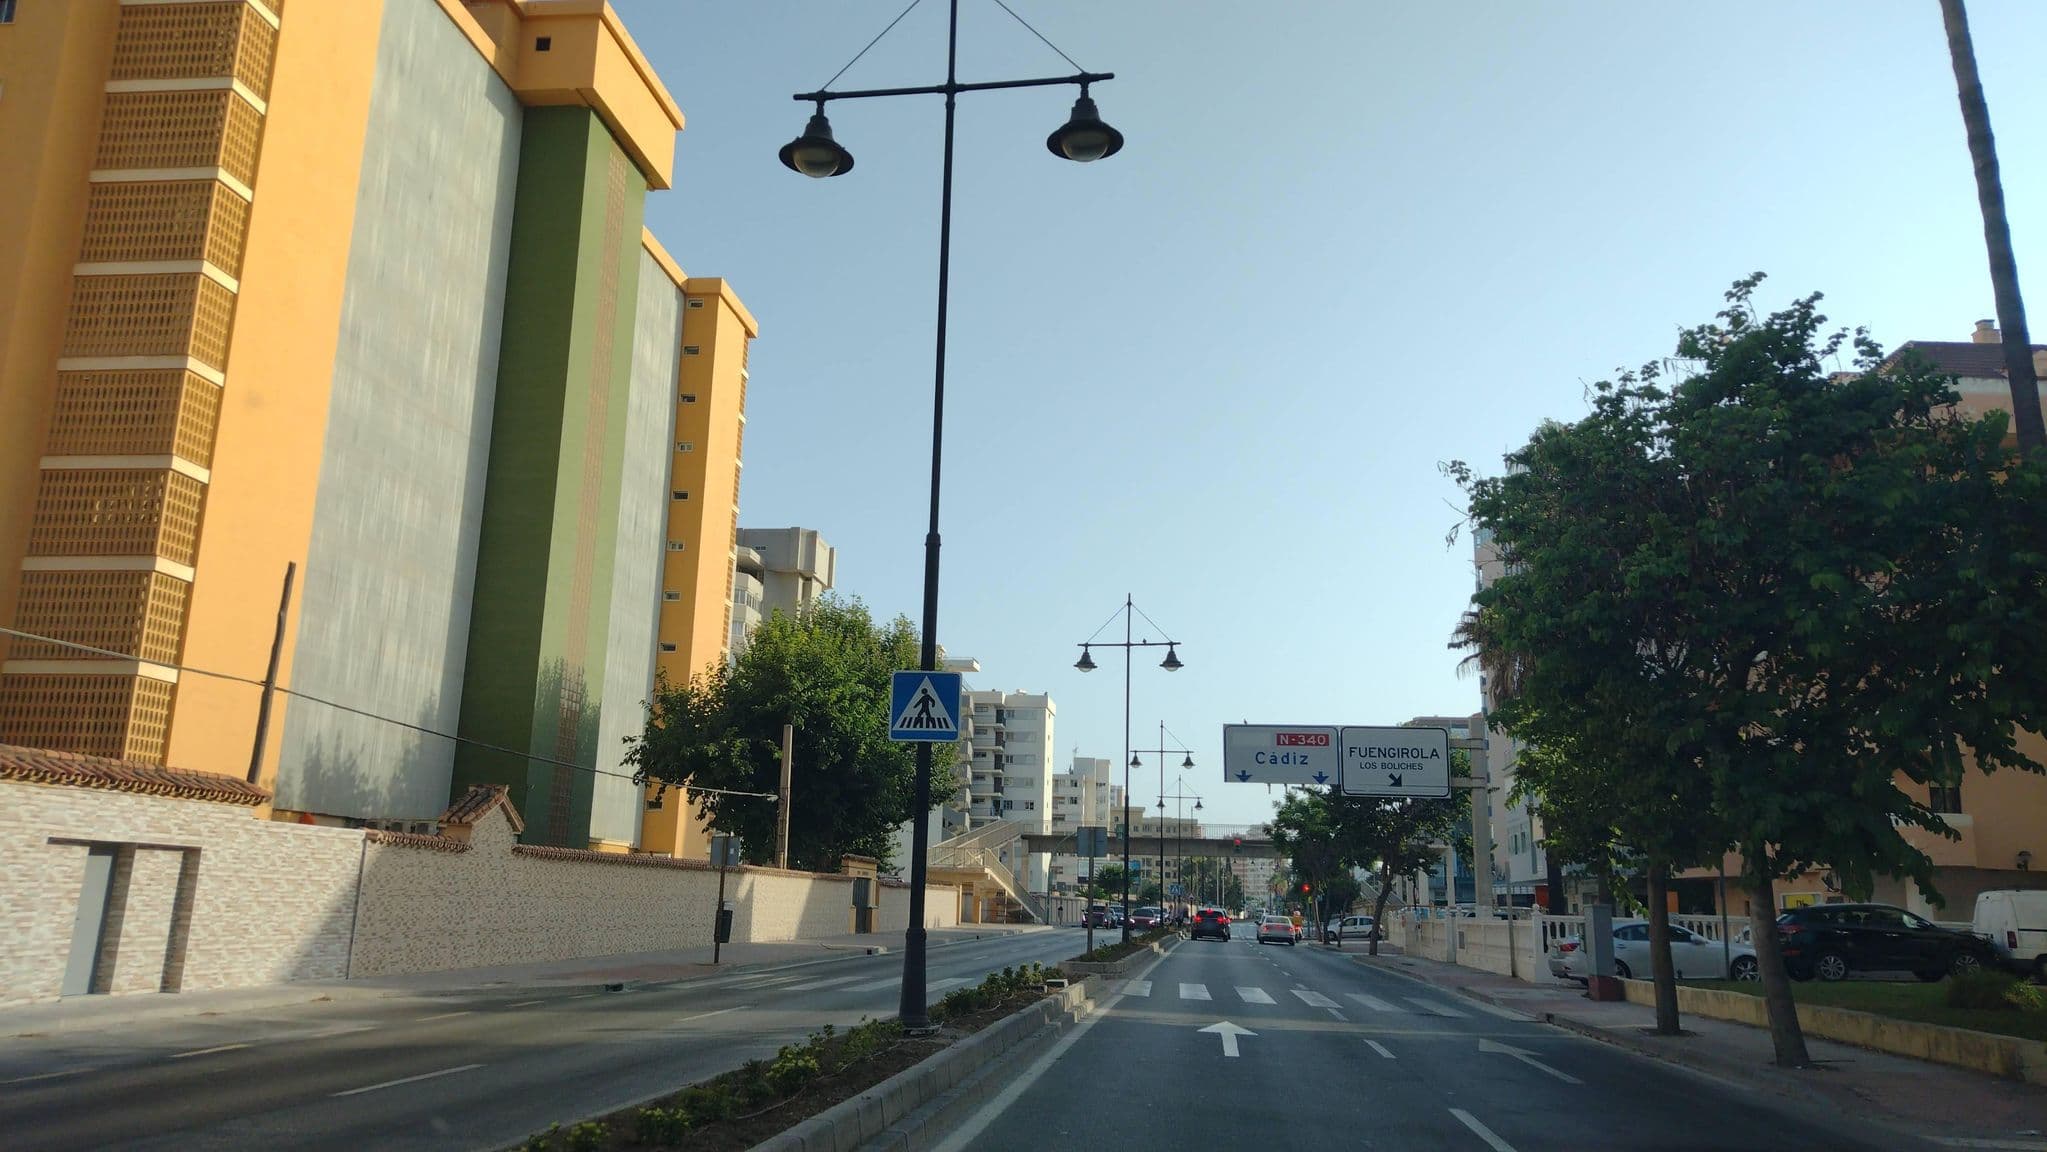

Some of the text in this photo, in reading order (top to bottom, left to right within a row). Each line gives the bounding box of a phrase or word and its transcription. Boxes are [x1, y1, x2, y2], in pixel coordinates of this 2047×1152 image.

[1280, 734, 1326, 745] N-340
[1255, 751, 1309, 765] Cádiz
[1349, 747, 1440, 759] FUENGIROLA
[1360, 761, 1423, 771] LOS BOLICHES
